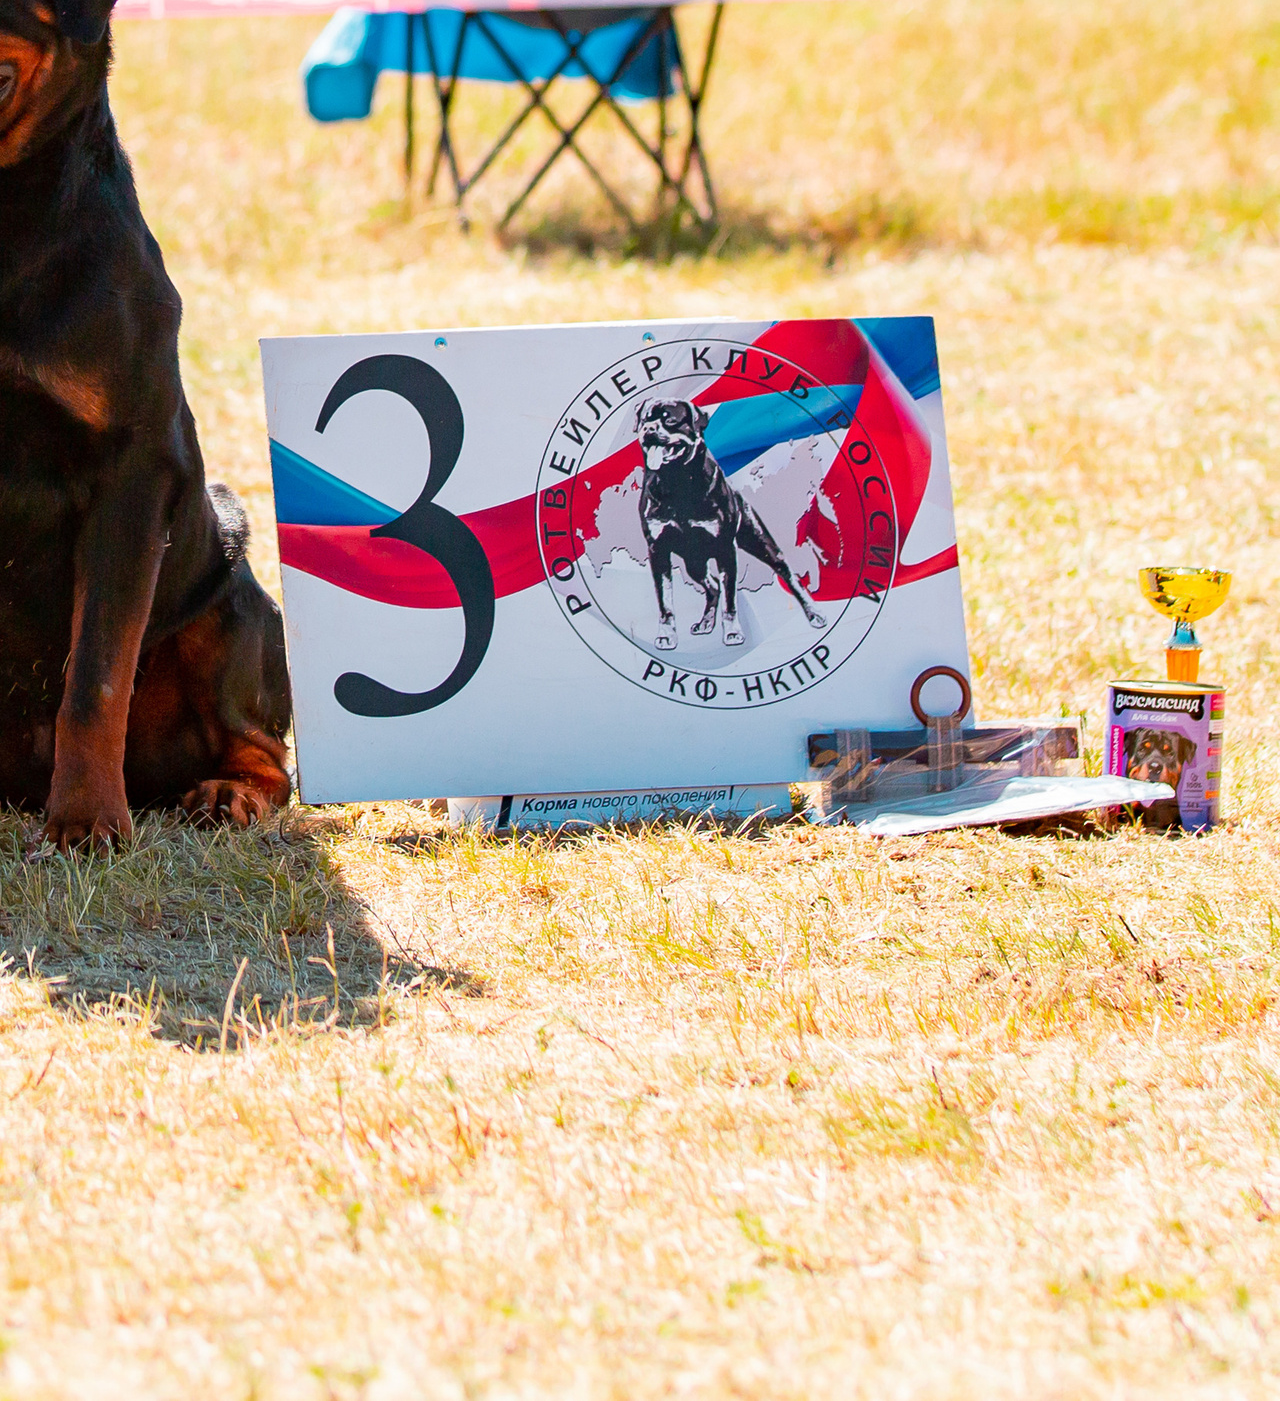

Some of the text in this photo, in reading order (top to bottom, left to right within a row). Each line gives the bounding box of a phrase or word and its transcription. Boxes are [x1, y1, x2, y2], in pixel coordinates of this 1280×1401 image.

[314, 353, 496, 718] 3
[543, 346, 893, 616] РОТВЕЙЛЕР КЛУБ РОССИИ
[641, 644, 831, 703] РКФ-НКПР
[521, 787, 727, 814] Корма нового поколения
